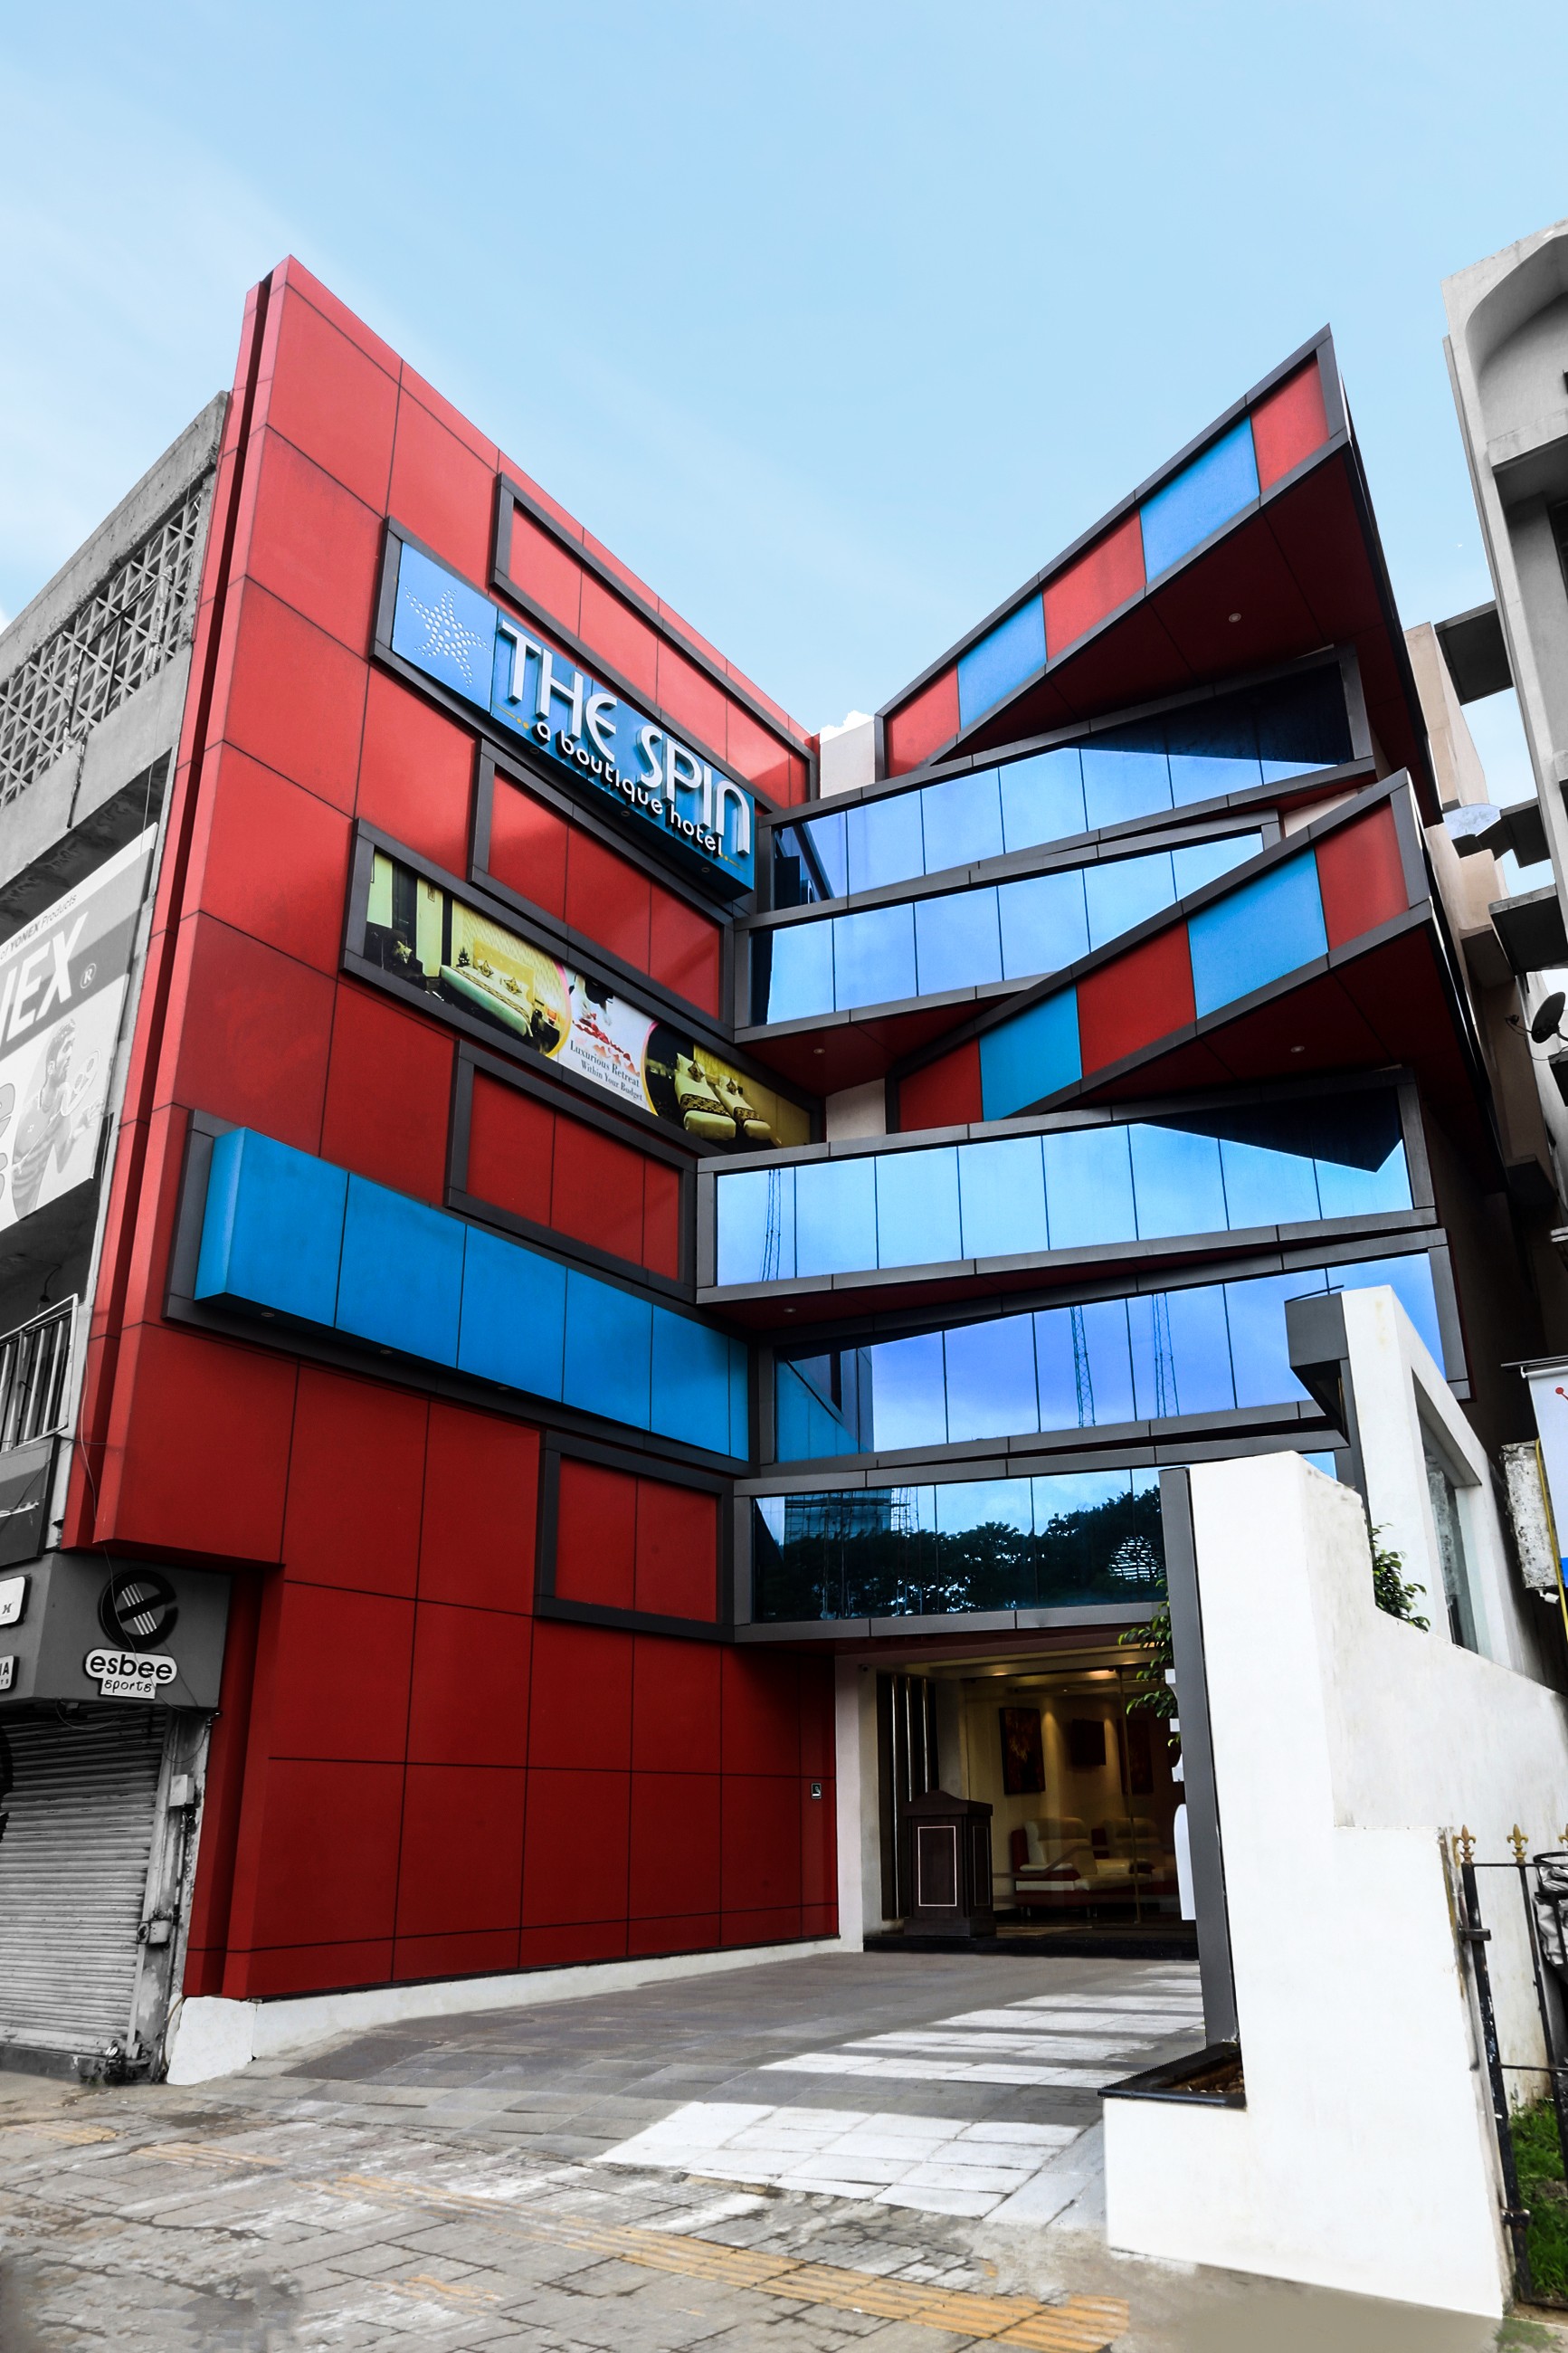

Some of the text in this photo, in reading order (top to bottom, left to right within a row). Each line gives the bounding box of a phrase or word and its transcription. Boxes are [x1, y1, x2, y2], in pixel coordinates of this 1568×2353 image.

[499, 619, 751, 855] THE SPIN
[536, 721, 722, 855] a boutique hotel
[10, 920, 41, 952] YONEX
[41, 894, 77, 928] Products
[570, 1040, 640, 1088] Luxurious Retreat
[581, 1060, 643, 1101] Within Your Budget
[90, 1654, 173, 1681] esbee
[104, 1680, 153, 1693] sports
